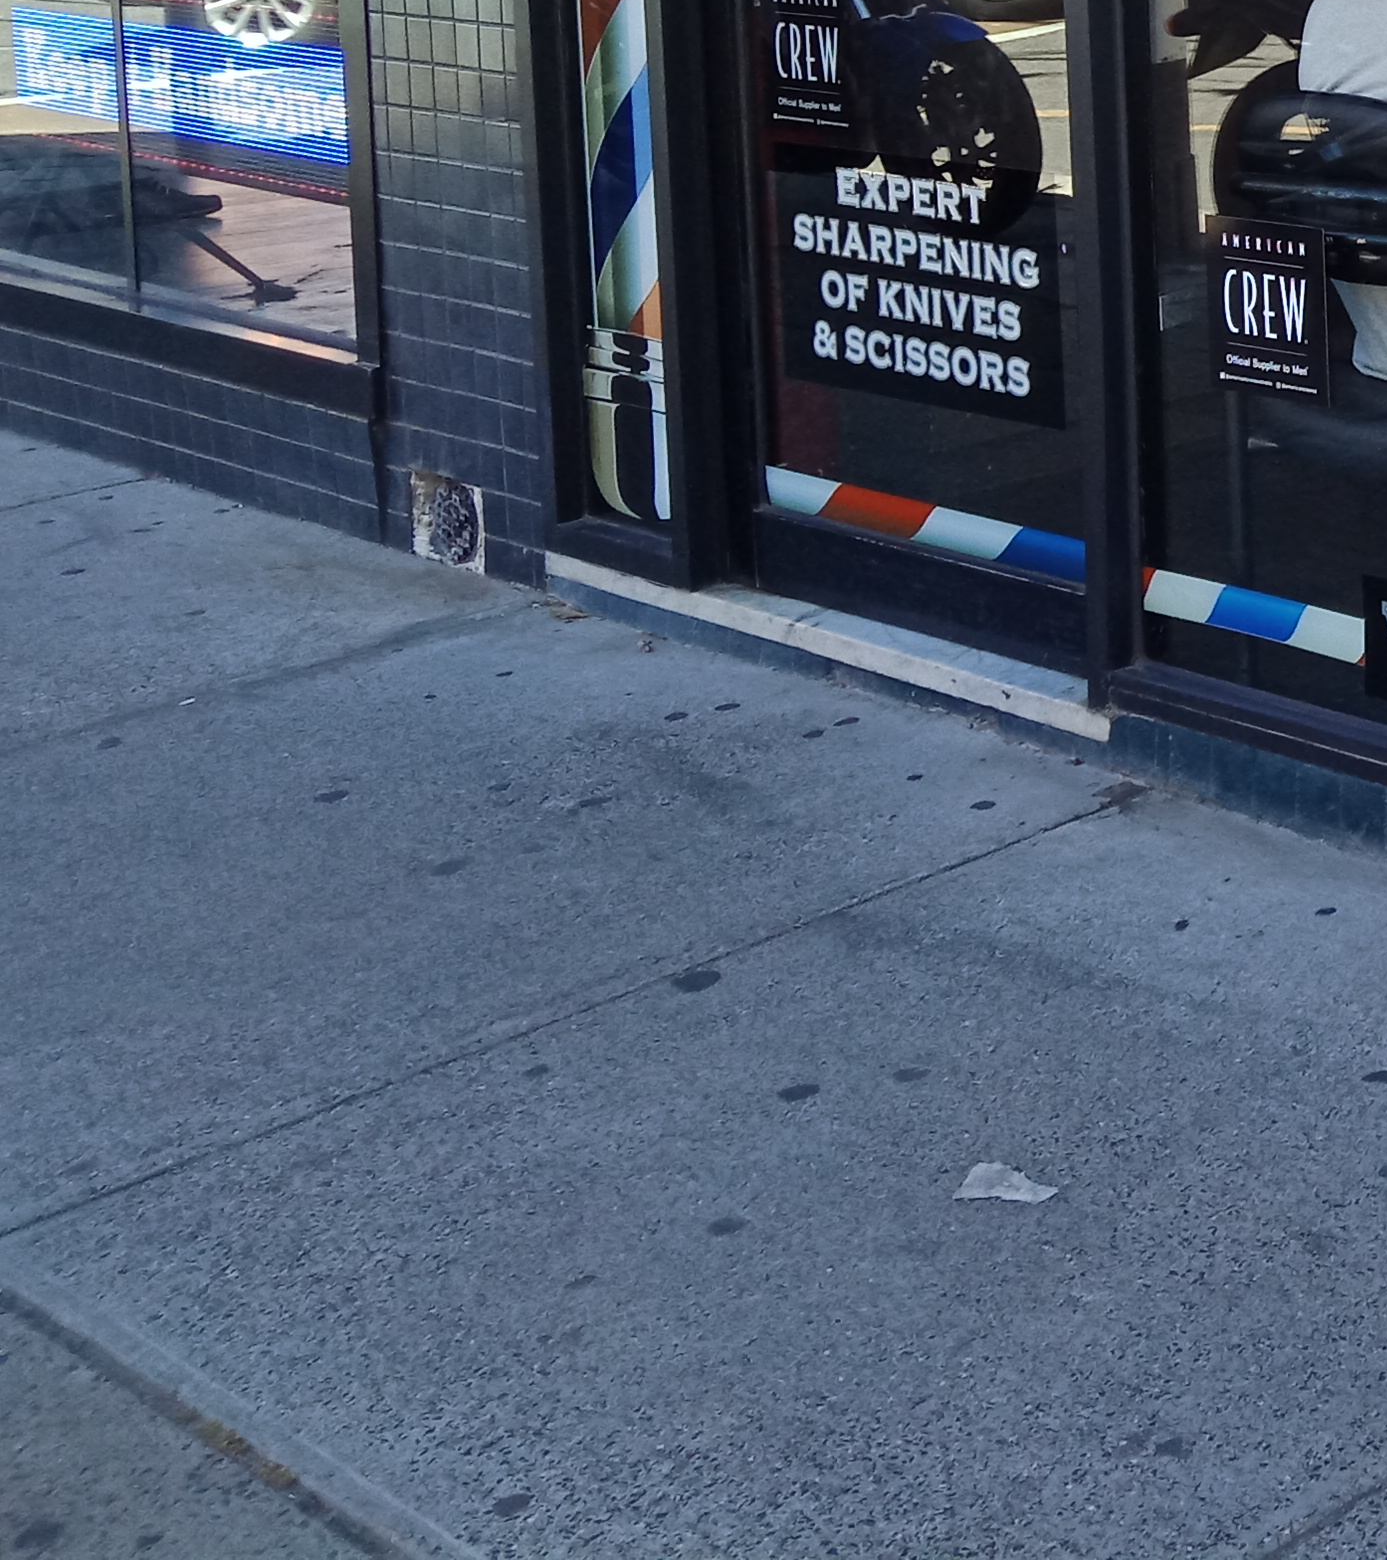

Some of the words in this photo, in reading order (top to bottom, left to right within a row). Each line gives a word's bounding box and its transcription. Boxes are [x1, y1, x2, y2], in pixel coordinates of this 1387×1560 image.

[774, 21, 839, 85] CREW
[834, 165, 993, 225] EXPERT
[793, 212, 1041, 290] SHARPENING
[1220, 231, 1306, 257] AMERICAN
[820, 269, 869, 313] OF
[877, 277, 1022, 341] KNIVES
[1223, 268, 1307, 344] CREW
[812, 318, 838, 361] &
[844, 324, 1031, 398] SCISSORS
